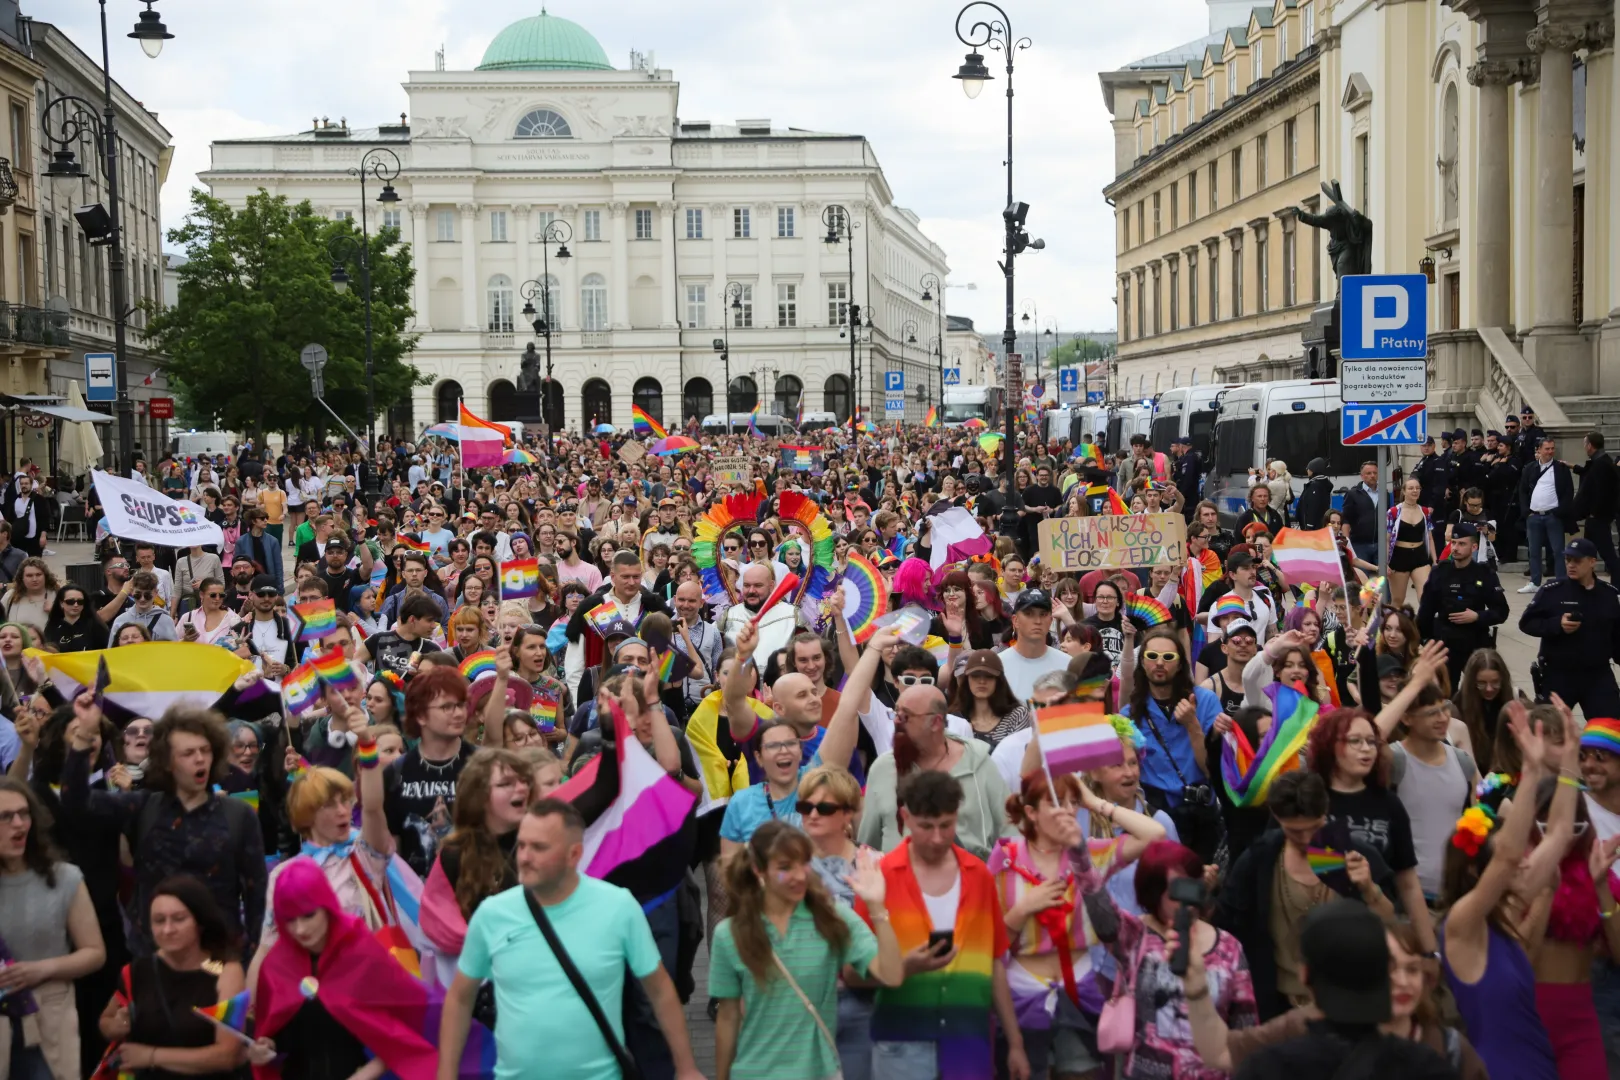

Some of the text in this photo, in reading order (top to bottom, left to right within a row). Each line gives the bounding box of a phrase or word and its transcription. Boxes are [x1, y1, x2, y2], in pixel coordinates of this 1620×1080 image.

[1361, 284, 1409, 349] P
[1381, 337, 1424, 350] Płatny
[1344, 365, 1362, 373] Tylko
[1378, 364, 1424, 372] nowożenców
[889, 373, 901, 389] P
[1343, 382, 1394, 390] pogrzebowych
[1404, 382, 1424, 390] godz.
[886, 400, 904, 409] TAXI
[23, 416, 50, 428] COFFEE
[1346, 408, 1424, 441] TAXI
[715, 471, 748, 481] KONRAD
[1094, 498, 1103, 510] P
[1051, 530, 1163, 550] KICH, NIKOGO
[382, 653, 408, 665] KYO
